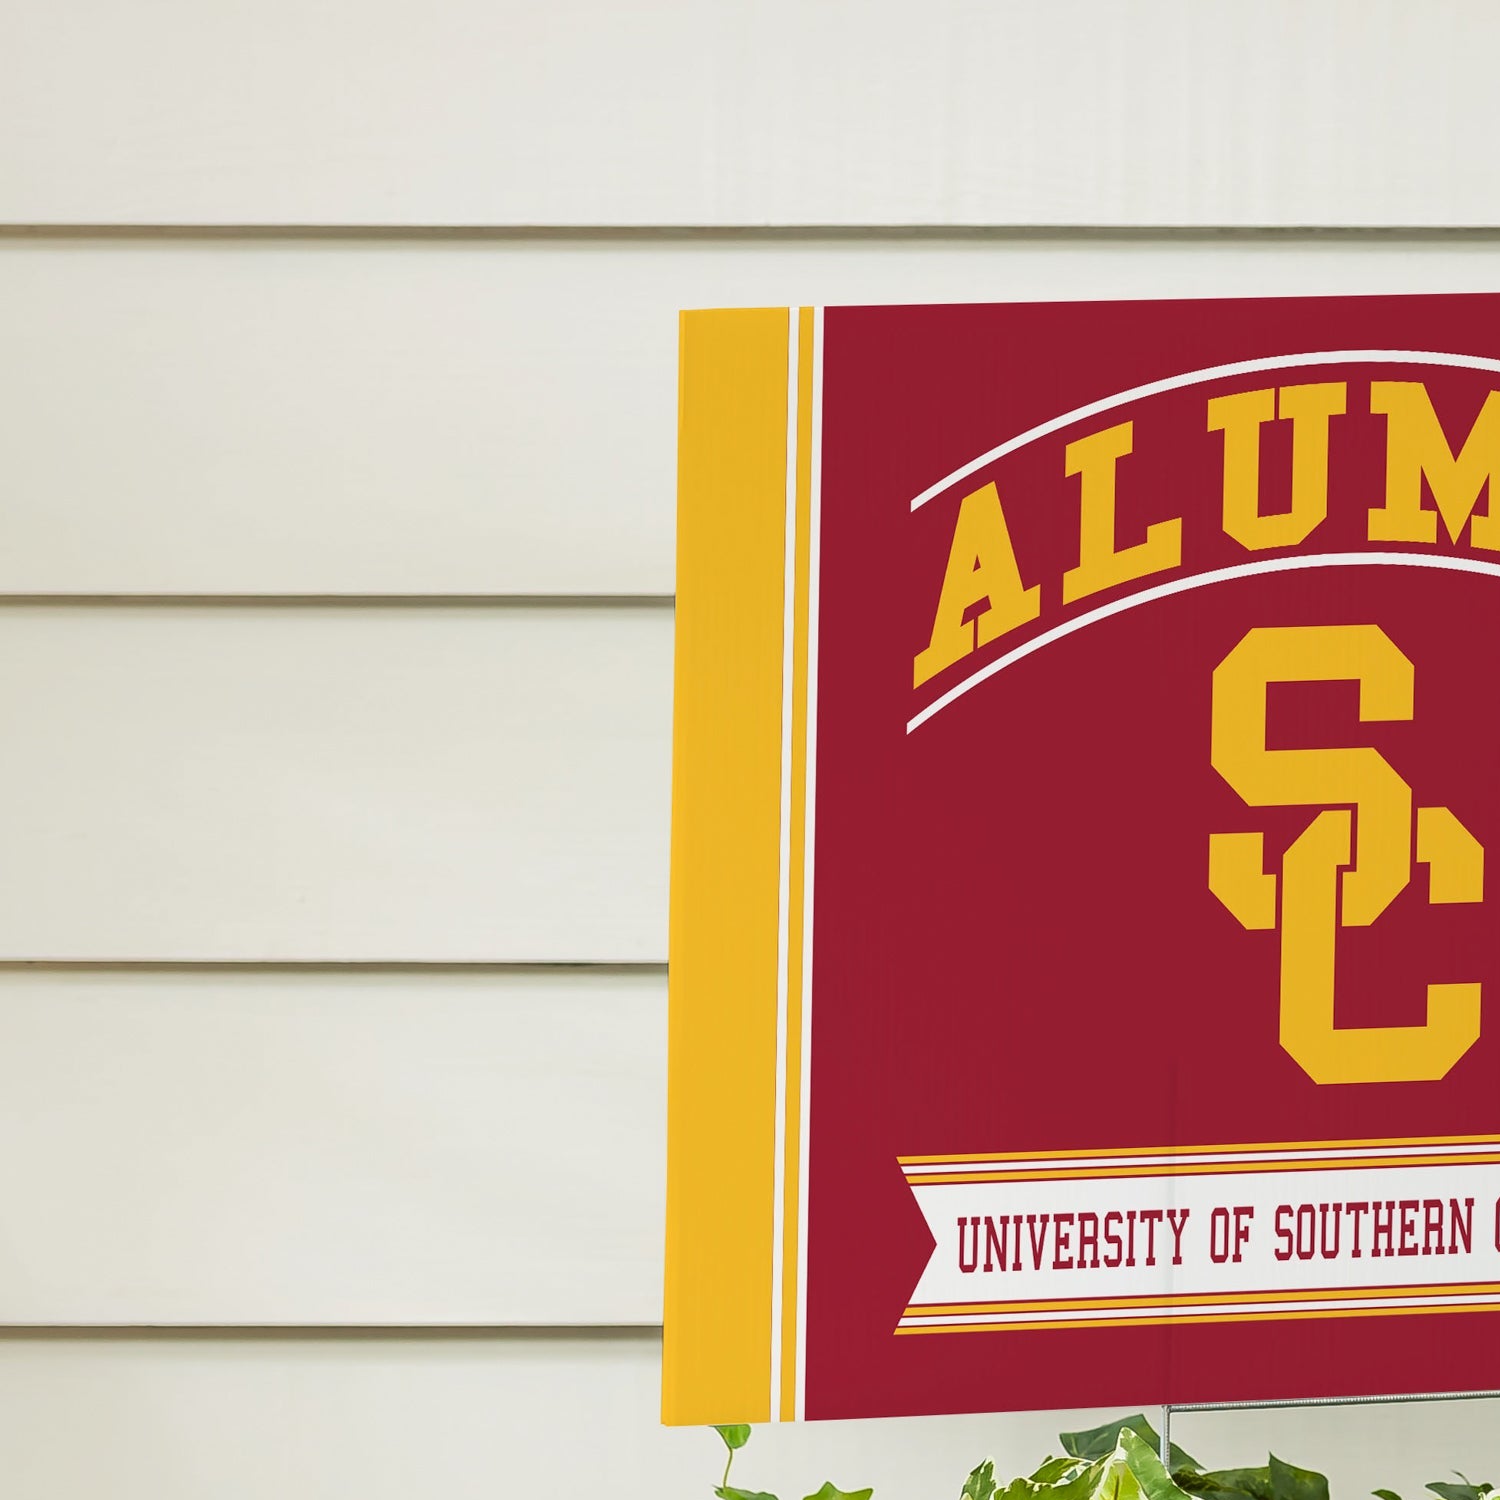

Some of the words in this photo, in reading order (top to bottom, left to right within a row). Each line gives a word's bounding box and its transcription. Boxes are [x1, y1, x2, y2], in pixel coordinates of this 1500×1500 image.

[1209, 625, 1484, 1085] SC
[957, 1208, 1190, 1274] UNIVERSITY
[1210, 1206, 1254, 1264] OF
[1274, 1197, 1475, 1261] SOUTHERN
